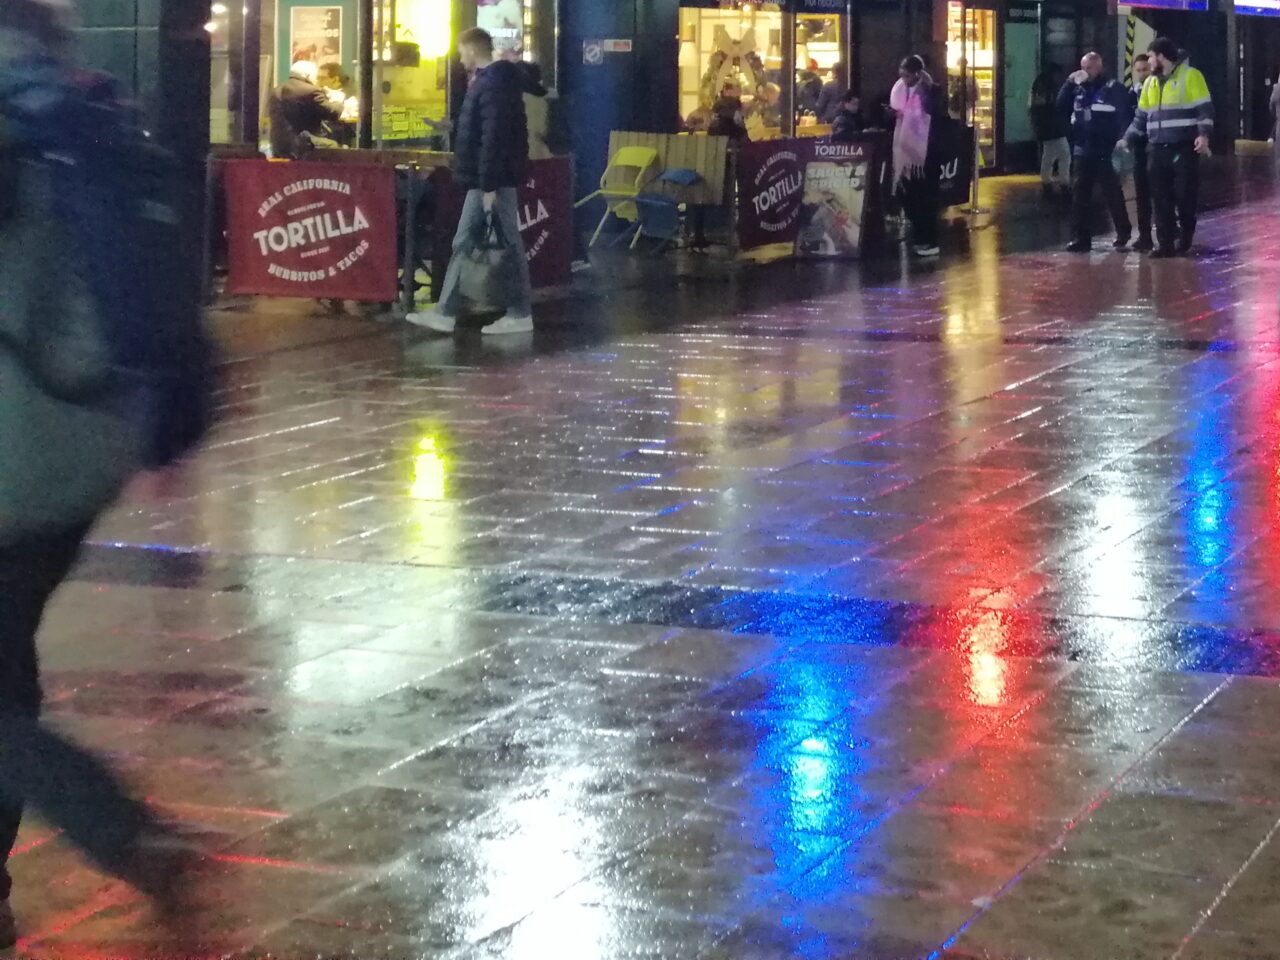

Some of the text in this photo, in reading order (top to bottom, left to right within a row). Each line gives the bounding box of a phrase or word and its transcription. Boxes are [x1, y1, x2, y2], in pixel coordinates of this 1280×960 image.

[815, 145, 864, 156] TORTILLA
[258, 192, 283, 218] REAL
[283, 178, 351, 196] CALIFORNIA
[253, 205, 370, 257] TORTILLA
[267, 263, 325, 282] BURRITOS
[328, 266, 337, 277] &
[337, 240, 369, 271] TACOS
